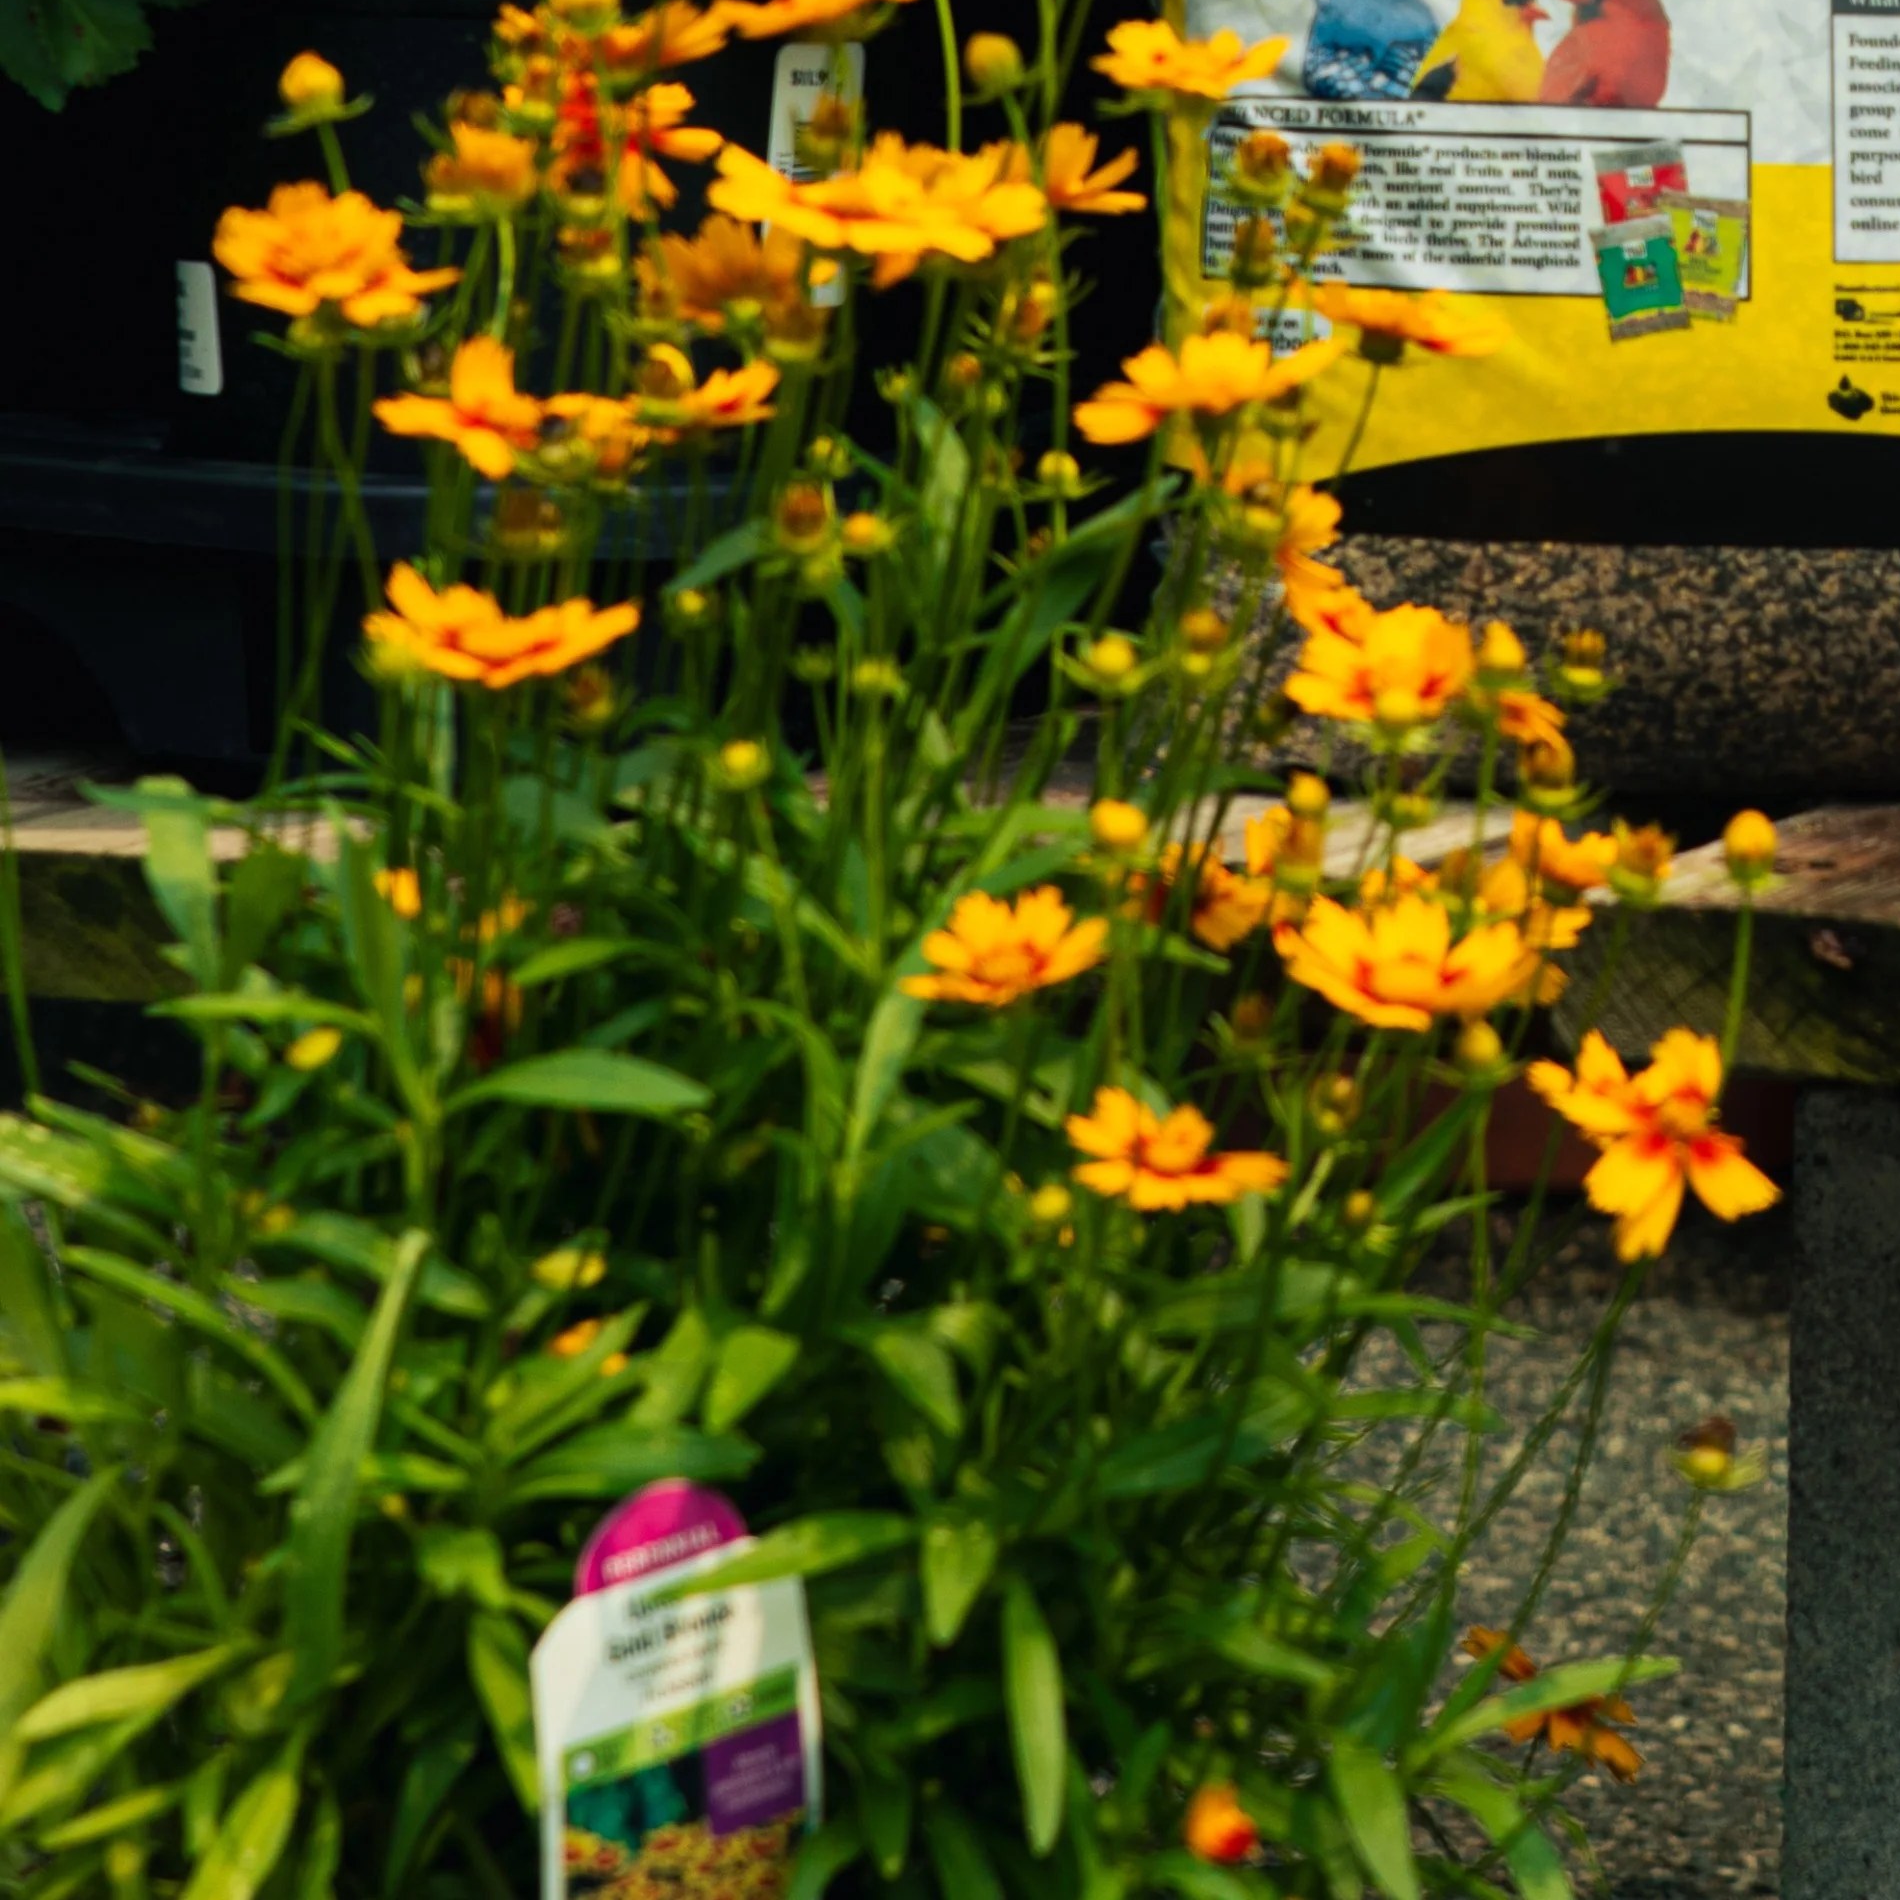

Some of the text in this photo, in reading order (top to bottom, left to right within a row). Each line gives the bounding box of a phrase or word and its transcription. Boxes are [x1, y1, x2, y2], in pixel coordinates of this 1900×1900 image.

[1849, 104, 1896, 121] group
[1849, 129, 1890, 140] come
[1850, 171, 1883, 185] bird
[1849, 218, 1900, 231] online
